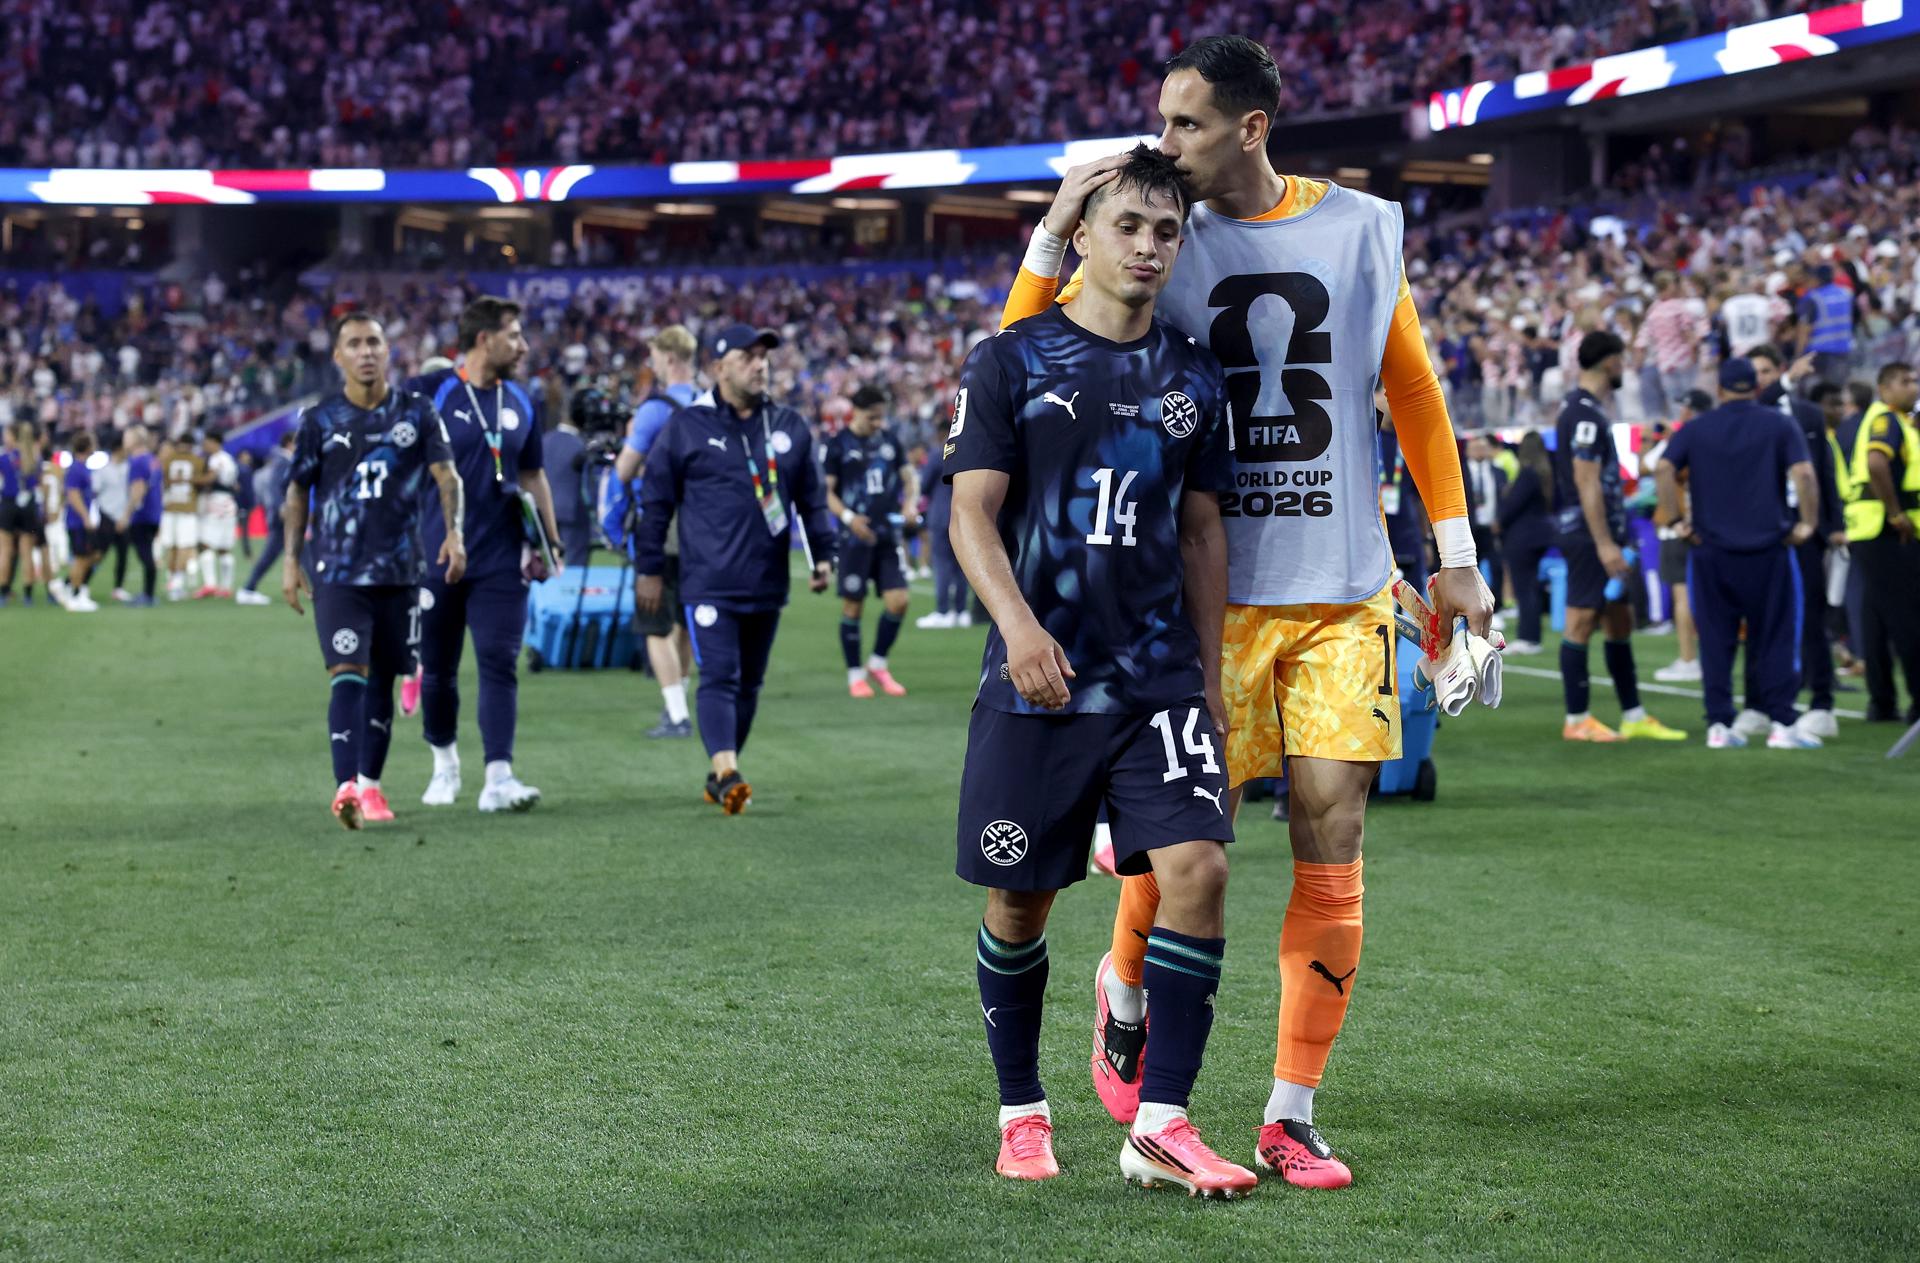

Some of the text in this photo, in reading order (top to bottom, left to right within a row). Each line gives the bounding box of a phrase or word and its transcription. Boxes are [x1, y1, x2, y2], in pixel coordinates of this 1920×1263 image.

[1173, 395, 1185, 404] APF
[1249, 425, 1301, 446] FIFA
[355, 460, 388, 500] 17
[1235, 471, 1333, 487] ORLD CUP
[1086, 468, 1139, 546] 14
[1220, 490, 1333, 518] 2026
[1376, 624, 1392, 695] 1
[1149, 707, 1221, 783] 14
[997, 824, 1013, 832] APF
